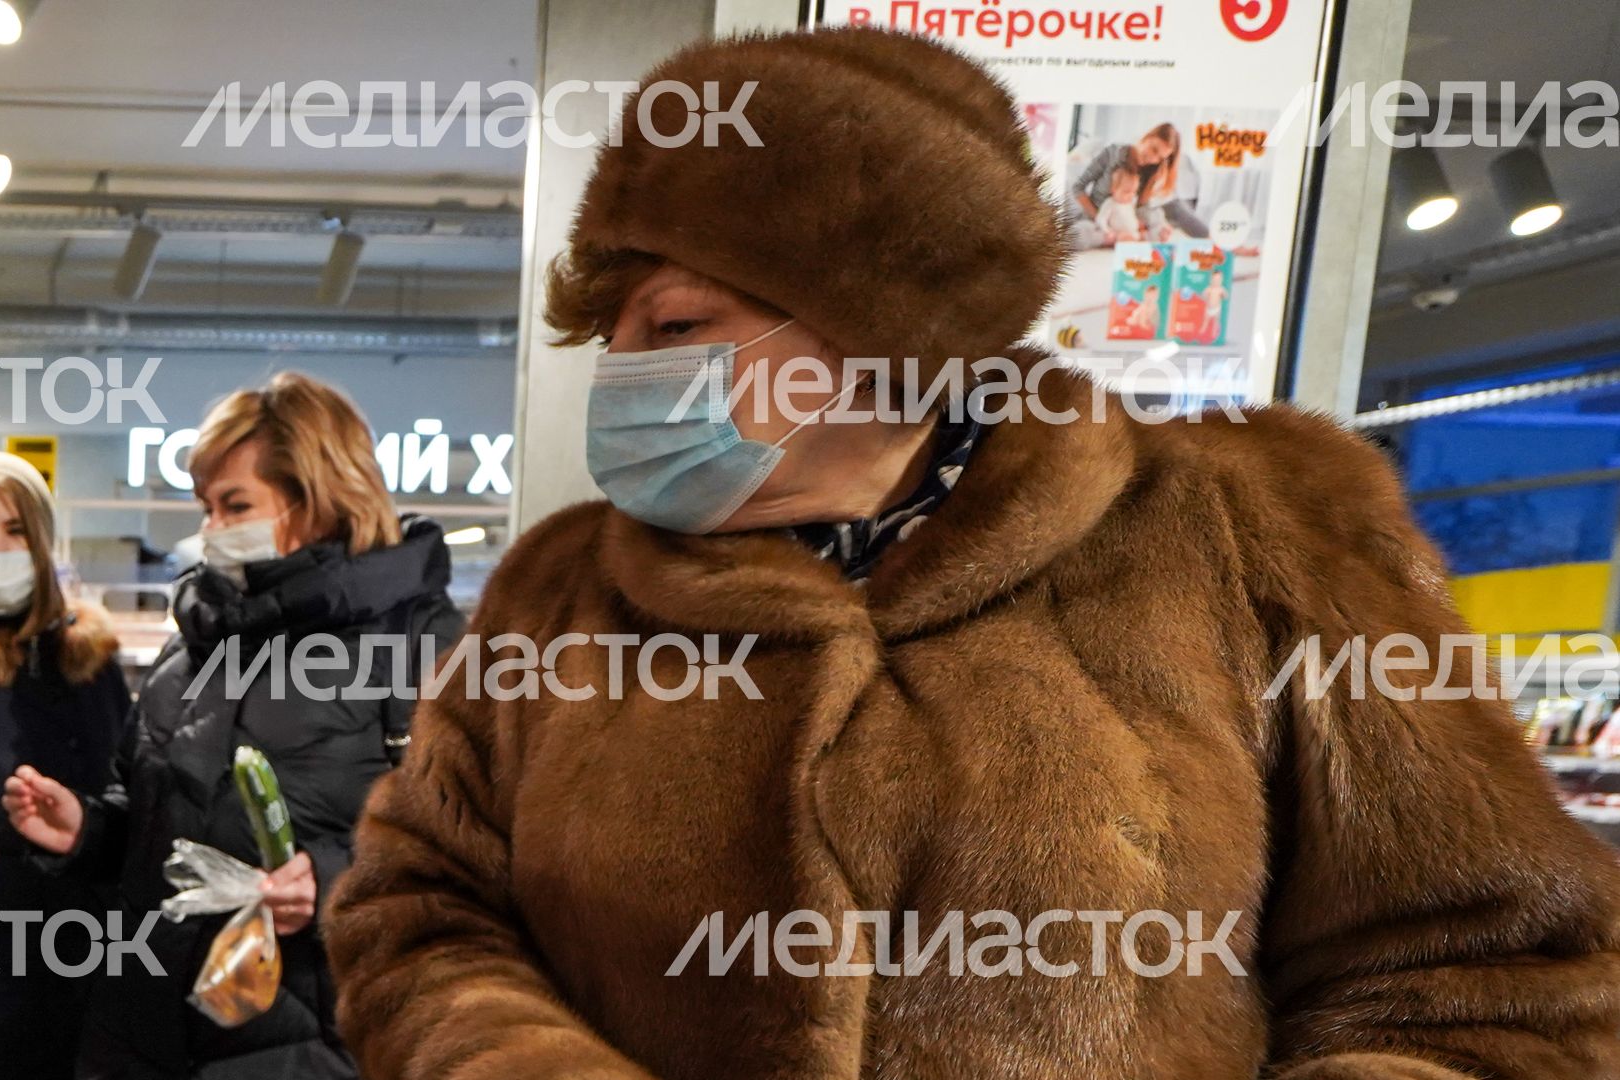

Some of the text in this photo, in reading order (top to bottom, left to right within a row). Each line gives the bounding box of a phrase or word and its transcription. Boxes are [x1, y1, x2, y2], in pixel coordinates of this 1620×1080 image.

[890, 0, 1163, 47] Пятёрочке!
[1197, 125, 1266, 155] Honey
[1216, 149, 1243, 165] Kid
[127, 419, 449, 495] ГОИЙ
